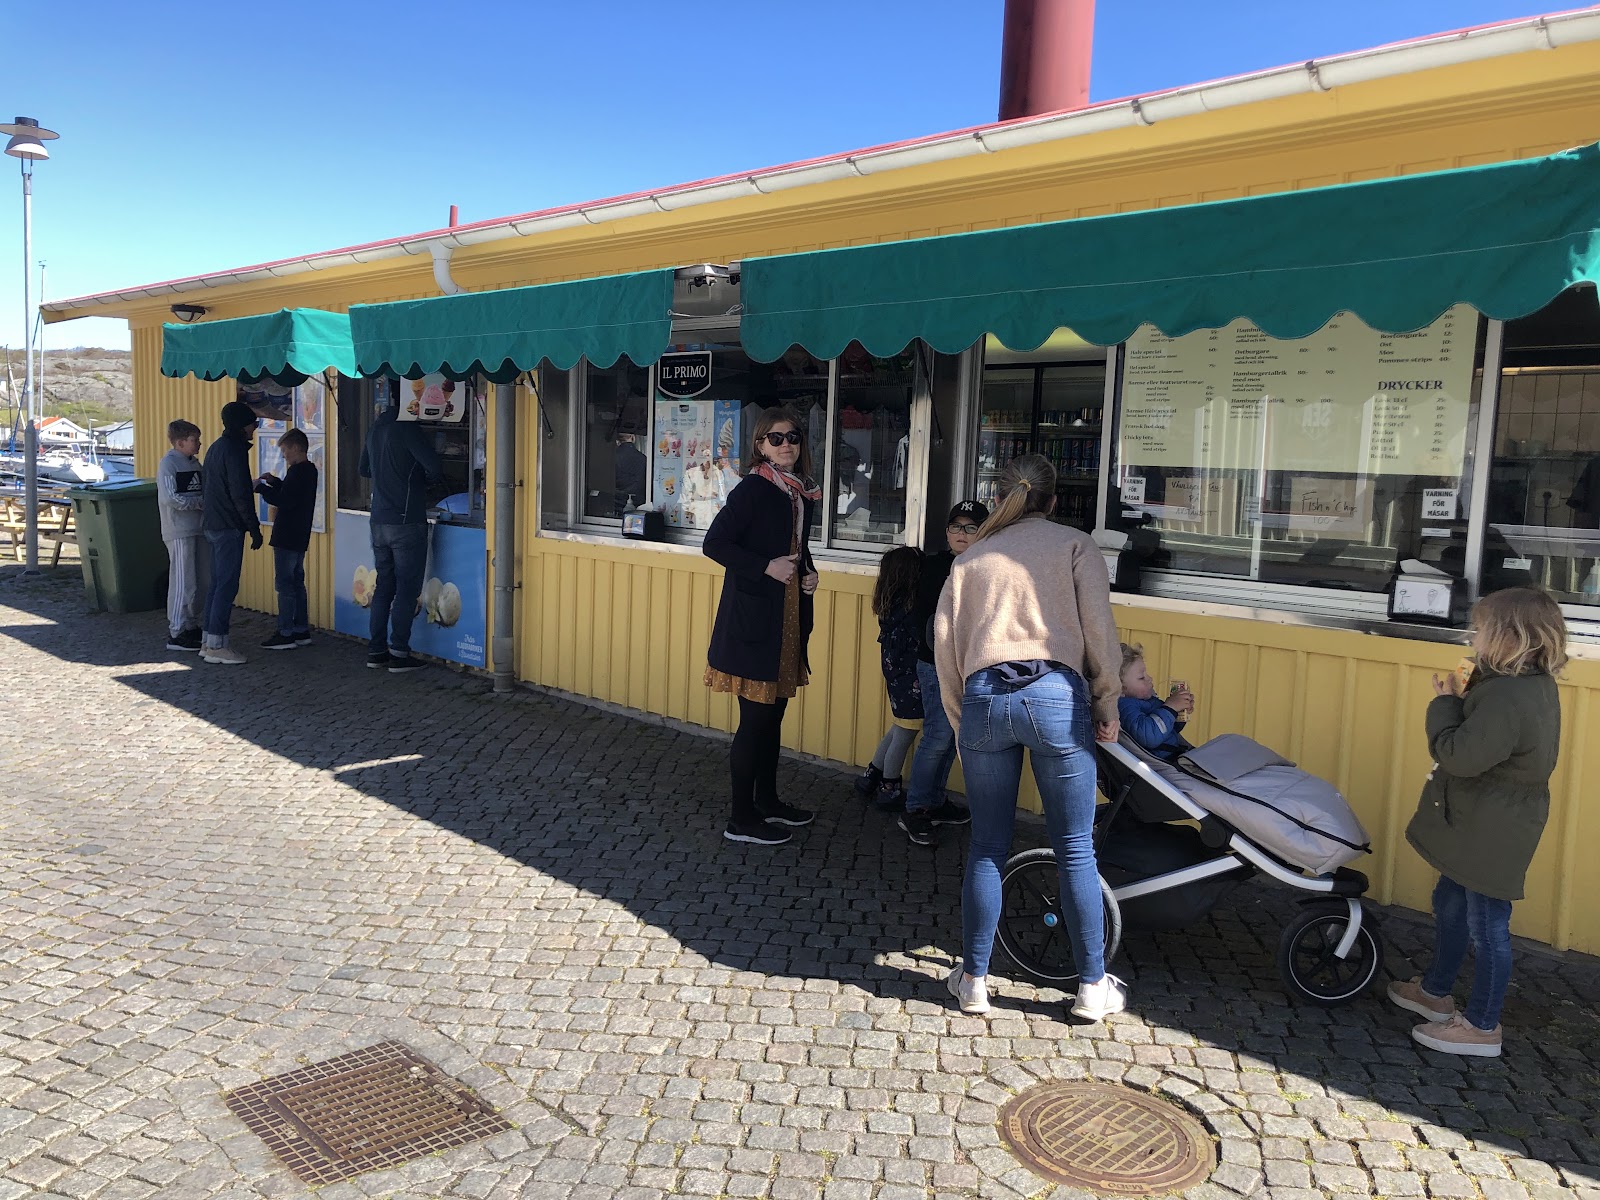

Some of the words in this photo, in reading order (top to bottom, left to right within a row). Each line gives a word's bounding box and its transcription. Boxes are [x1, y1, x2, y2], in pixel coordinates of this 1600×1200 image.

[662, 366, 673, 379] IL
[673, 365, 707, 379] PRIMO
[1377, 380, 1443, 391] DRYCKER
[960, 501, 974, 512] NY
[1301, 491, 1323, 514] Fish
[1432, 499, 1445, 507] FÖR
[1427, 509, 1449, 517] MÅSAR
